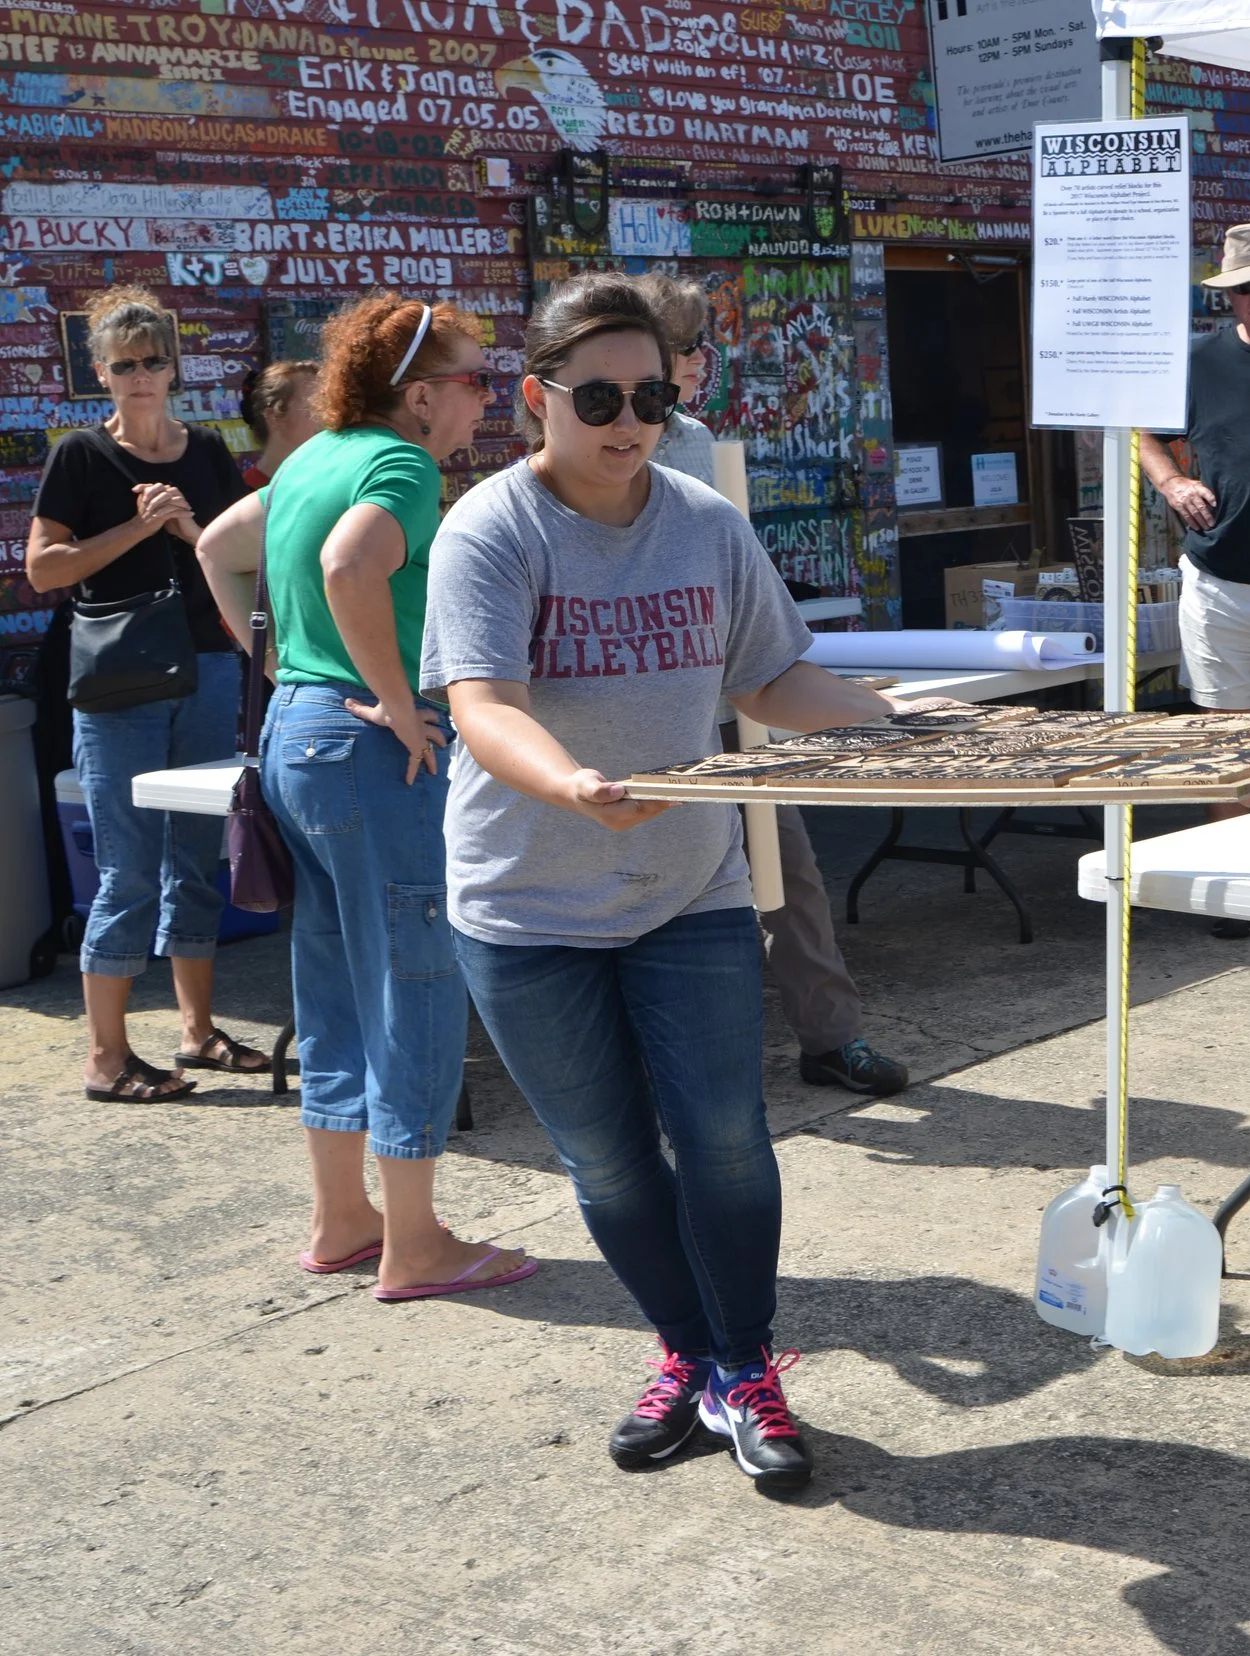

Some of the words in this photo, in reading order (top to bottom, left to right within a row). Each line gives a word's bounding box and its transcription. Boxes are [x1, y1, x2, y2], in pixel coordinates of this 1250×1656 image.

[427, 38, 498, 68] 2007
[945, 44, 975, 56] Hours:
[977, 36, 1001, 50] 10AM
[1011, 30, 1032, 44] 5PM
[1034, 27, 1056, 41] Mon.
[1067, 20, 1087, 33] Sat.
[978, 50, 1001, 64] 12PM
[1011, 44, 1032, 57] 5PM
[1034, 38, 1074, 53] Sundays
[92, 42, 262, 71] ANNAMARIE
[298, 55, 376, 92] Erik
[396, 64, 479, 97] Jana
[19, 113, 95, 138] ABIGAIL
[288, 89, 409, 134] Engaged
[417, 97, 541, 132] 07.05.05
[105, 118, 189, 142] MADISON
[200, 122, 256, 145] LUCAS
[266, 126, 328, 148] DRAKE
[607, 110, 675, 137] REID
[683, 117, 810, 150] HARTMAN
[1044, 130, 1178, 154] WISCONSIN
[857, 154, 889, 171] JOHN
[996, 163, 1029, 181] JOSH
[1046, 156, 1177, 176] ALPHABET
[619, 206, 672, 247] Holly
[752, 205, 801, 222] DAWN
[854, 214, 911, 238] LUKE
[977, 221, 1031, 240] HANNAH
[37, 217, 135, 249] BUCKY
[234, 222, 311, 252] BART
[326, 223, 405, 254] ERIKA
[408, 225, 492, 255] MILLER
[280, 256, 351, 285] JULY
[383, 255, 453, 286] 2003
[764, 517, 850, 553] CHASSEY
[794, 553, 849, 587] FINN
[530, 627, 724, 679] OLLEYBALL
